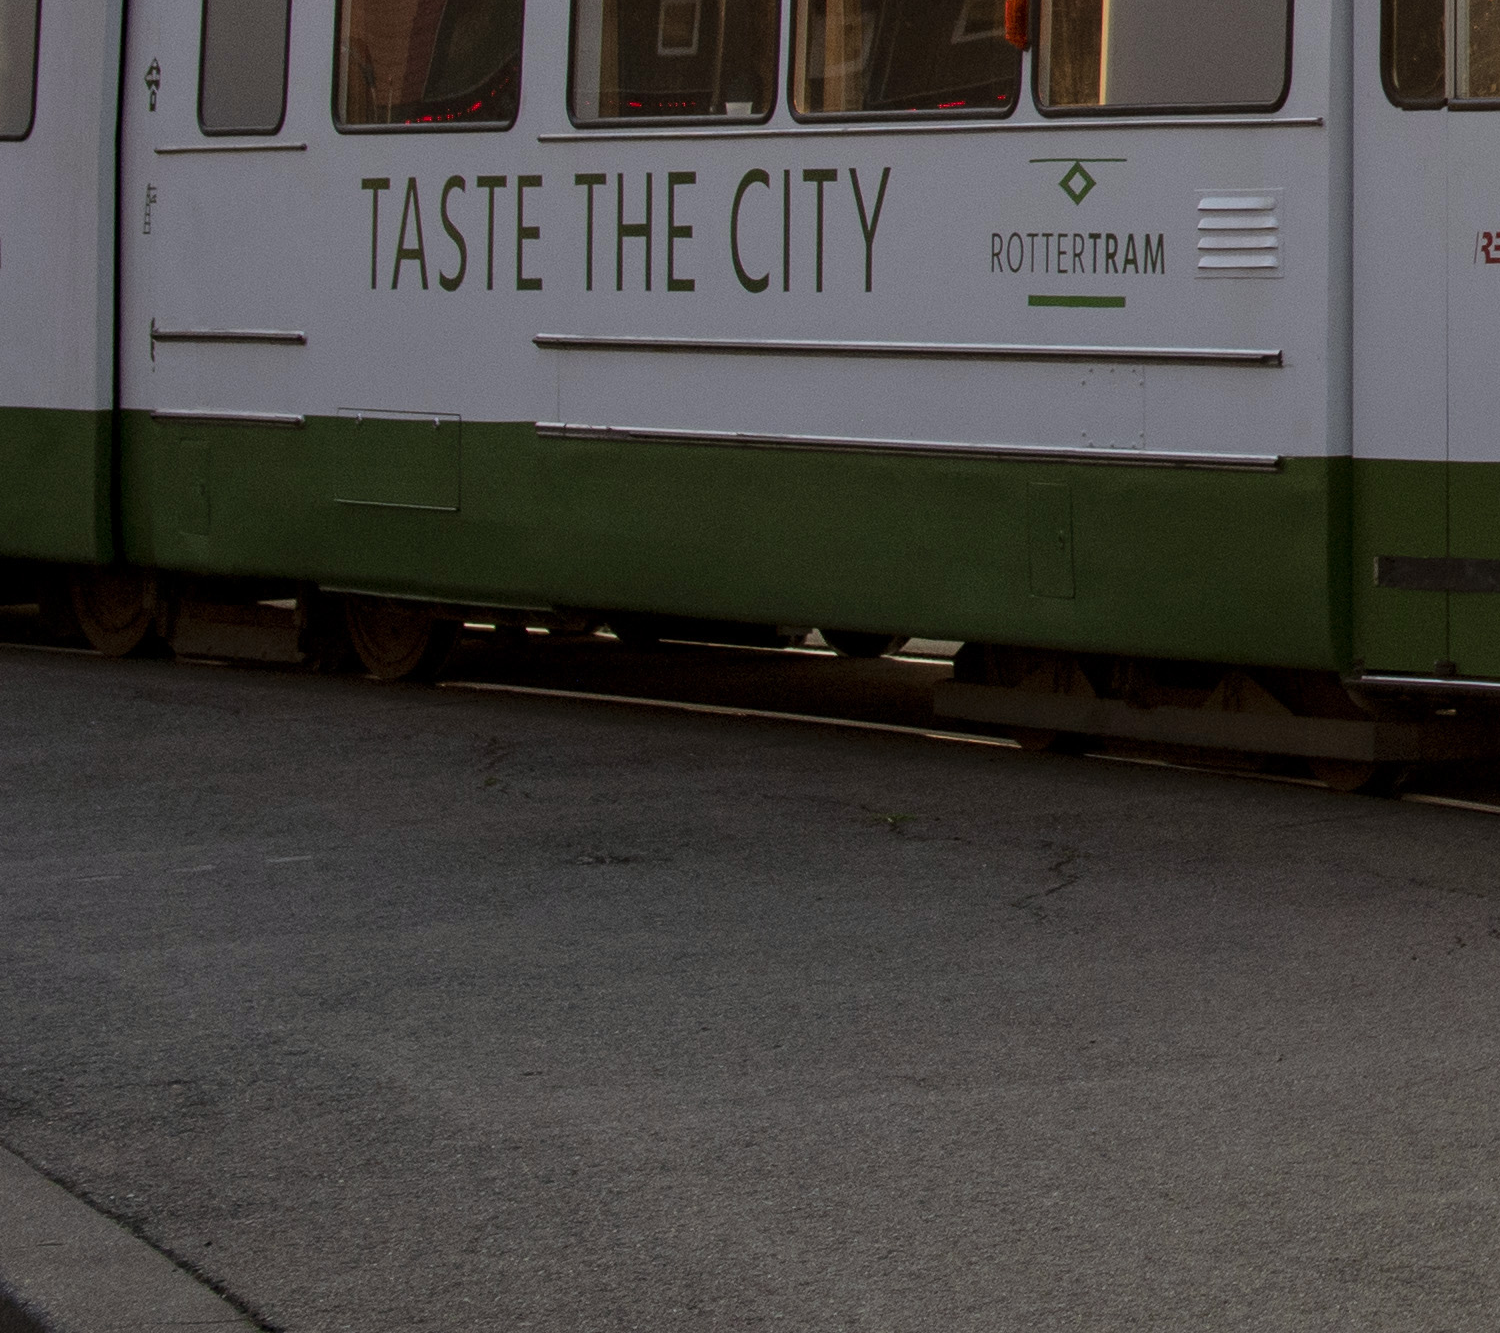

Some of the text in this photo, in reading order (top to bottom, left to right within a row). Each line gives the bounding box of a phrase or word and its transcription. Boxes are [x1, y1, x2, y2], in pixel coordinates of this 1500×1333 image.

[361, 166, 892, 294] TASTE THE CITY
[991, 232, 1166, 274] ROTTERTRAM
